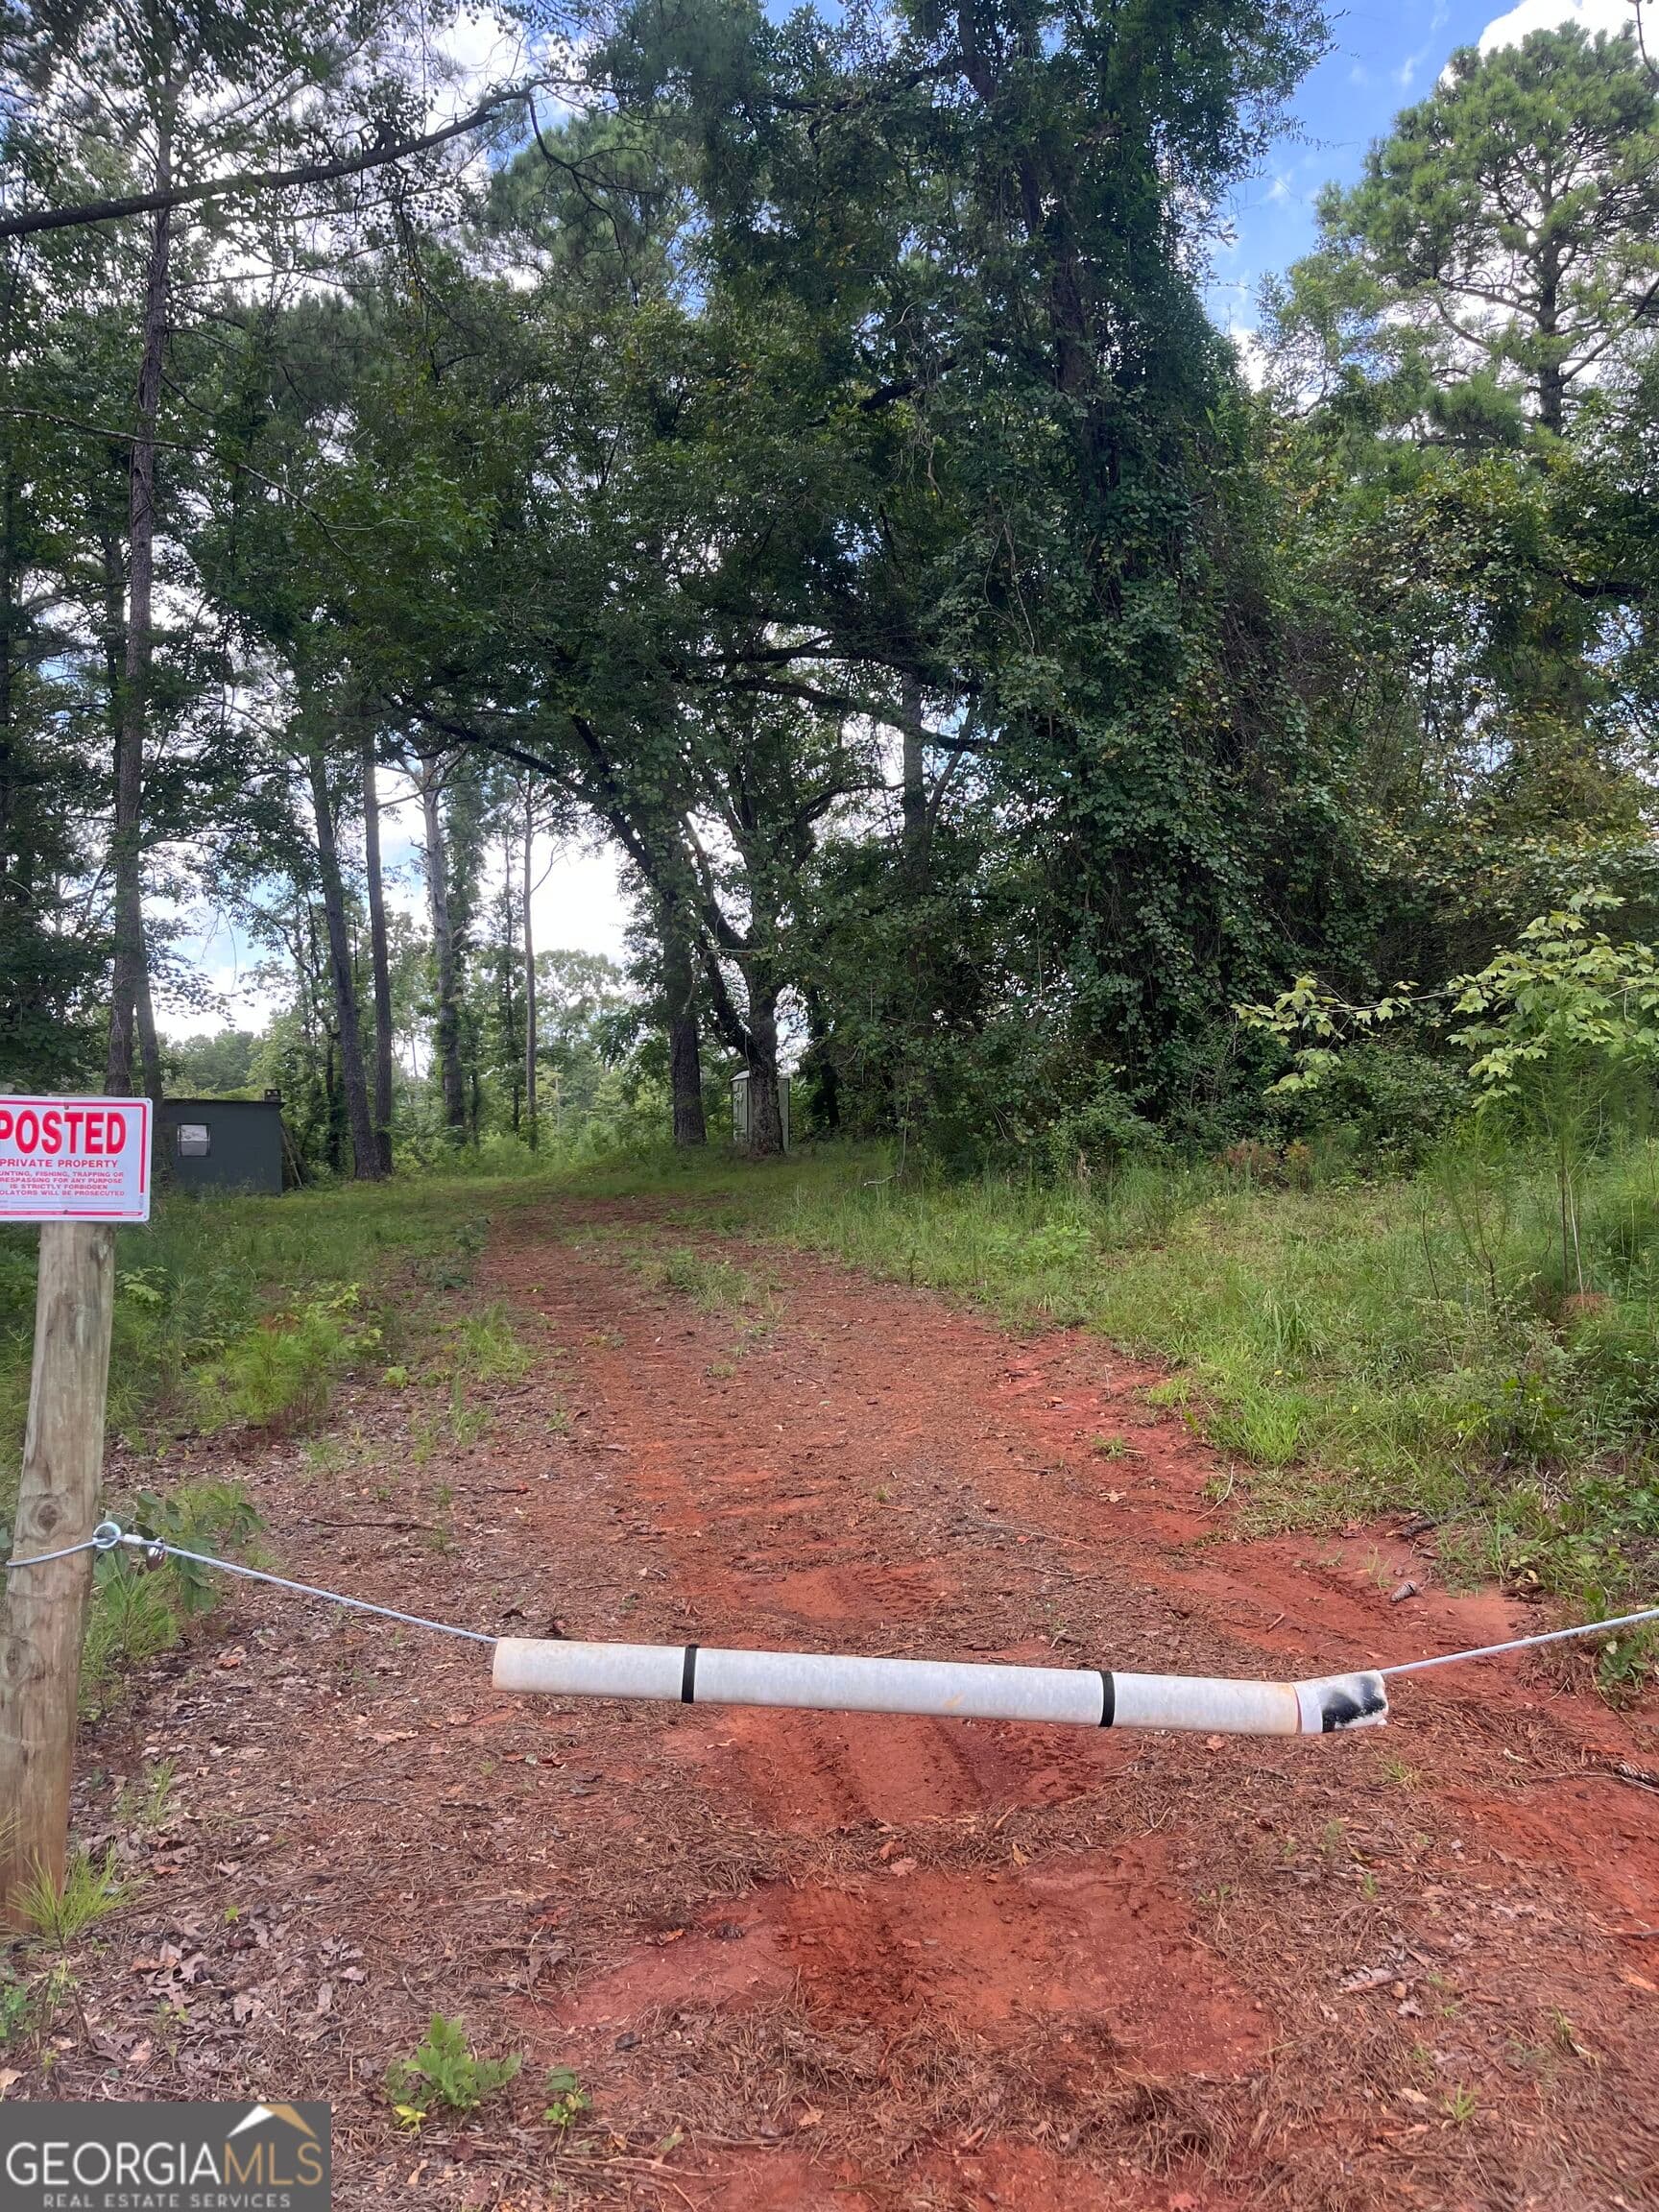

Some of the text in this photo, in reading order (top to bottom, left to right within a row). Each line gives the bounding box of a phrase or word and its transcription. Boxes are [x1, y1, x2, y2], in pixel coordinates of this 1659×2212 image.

[0, 1109, 127, 1155] POSTED
[0, 1159, 118, 1168] PRIVATE PROPERTY
